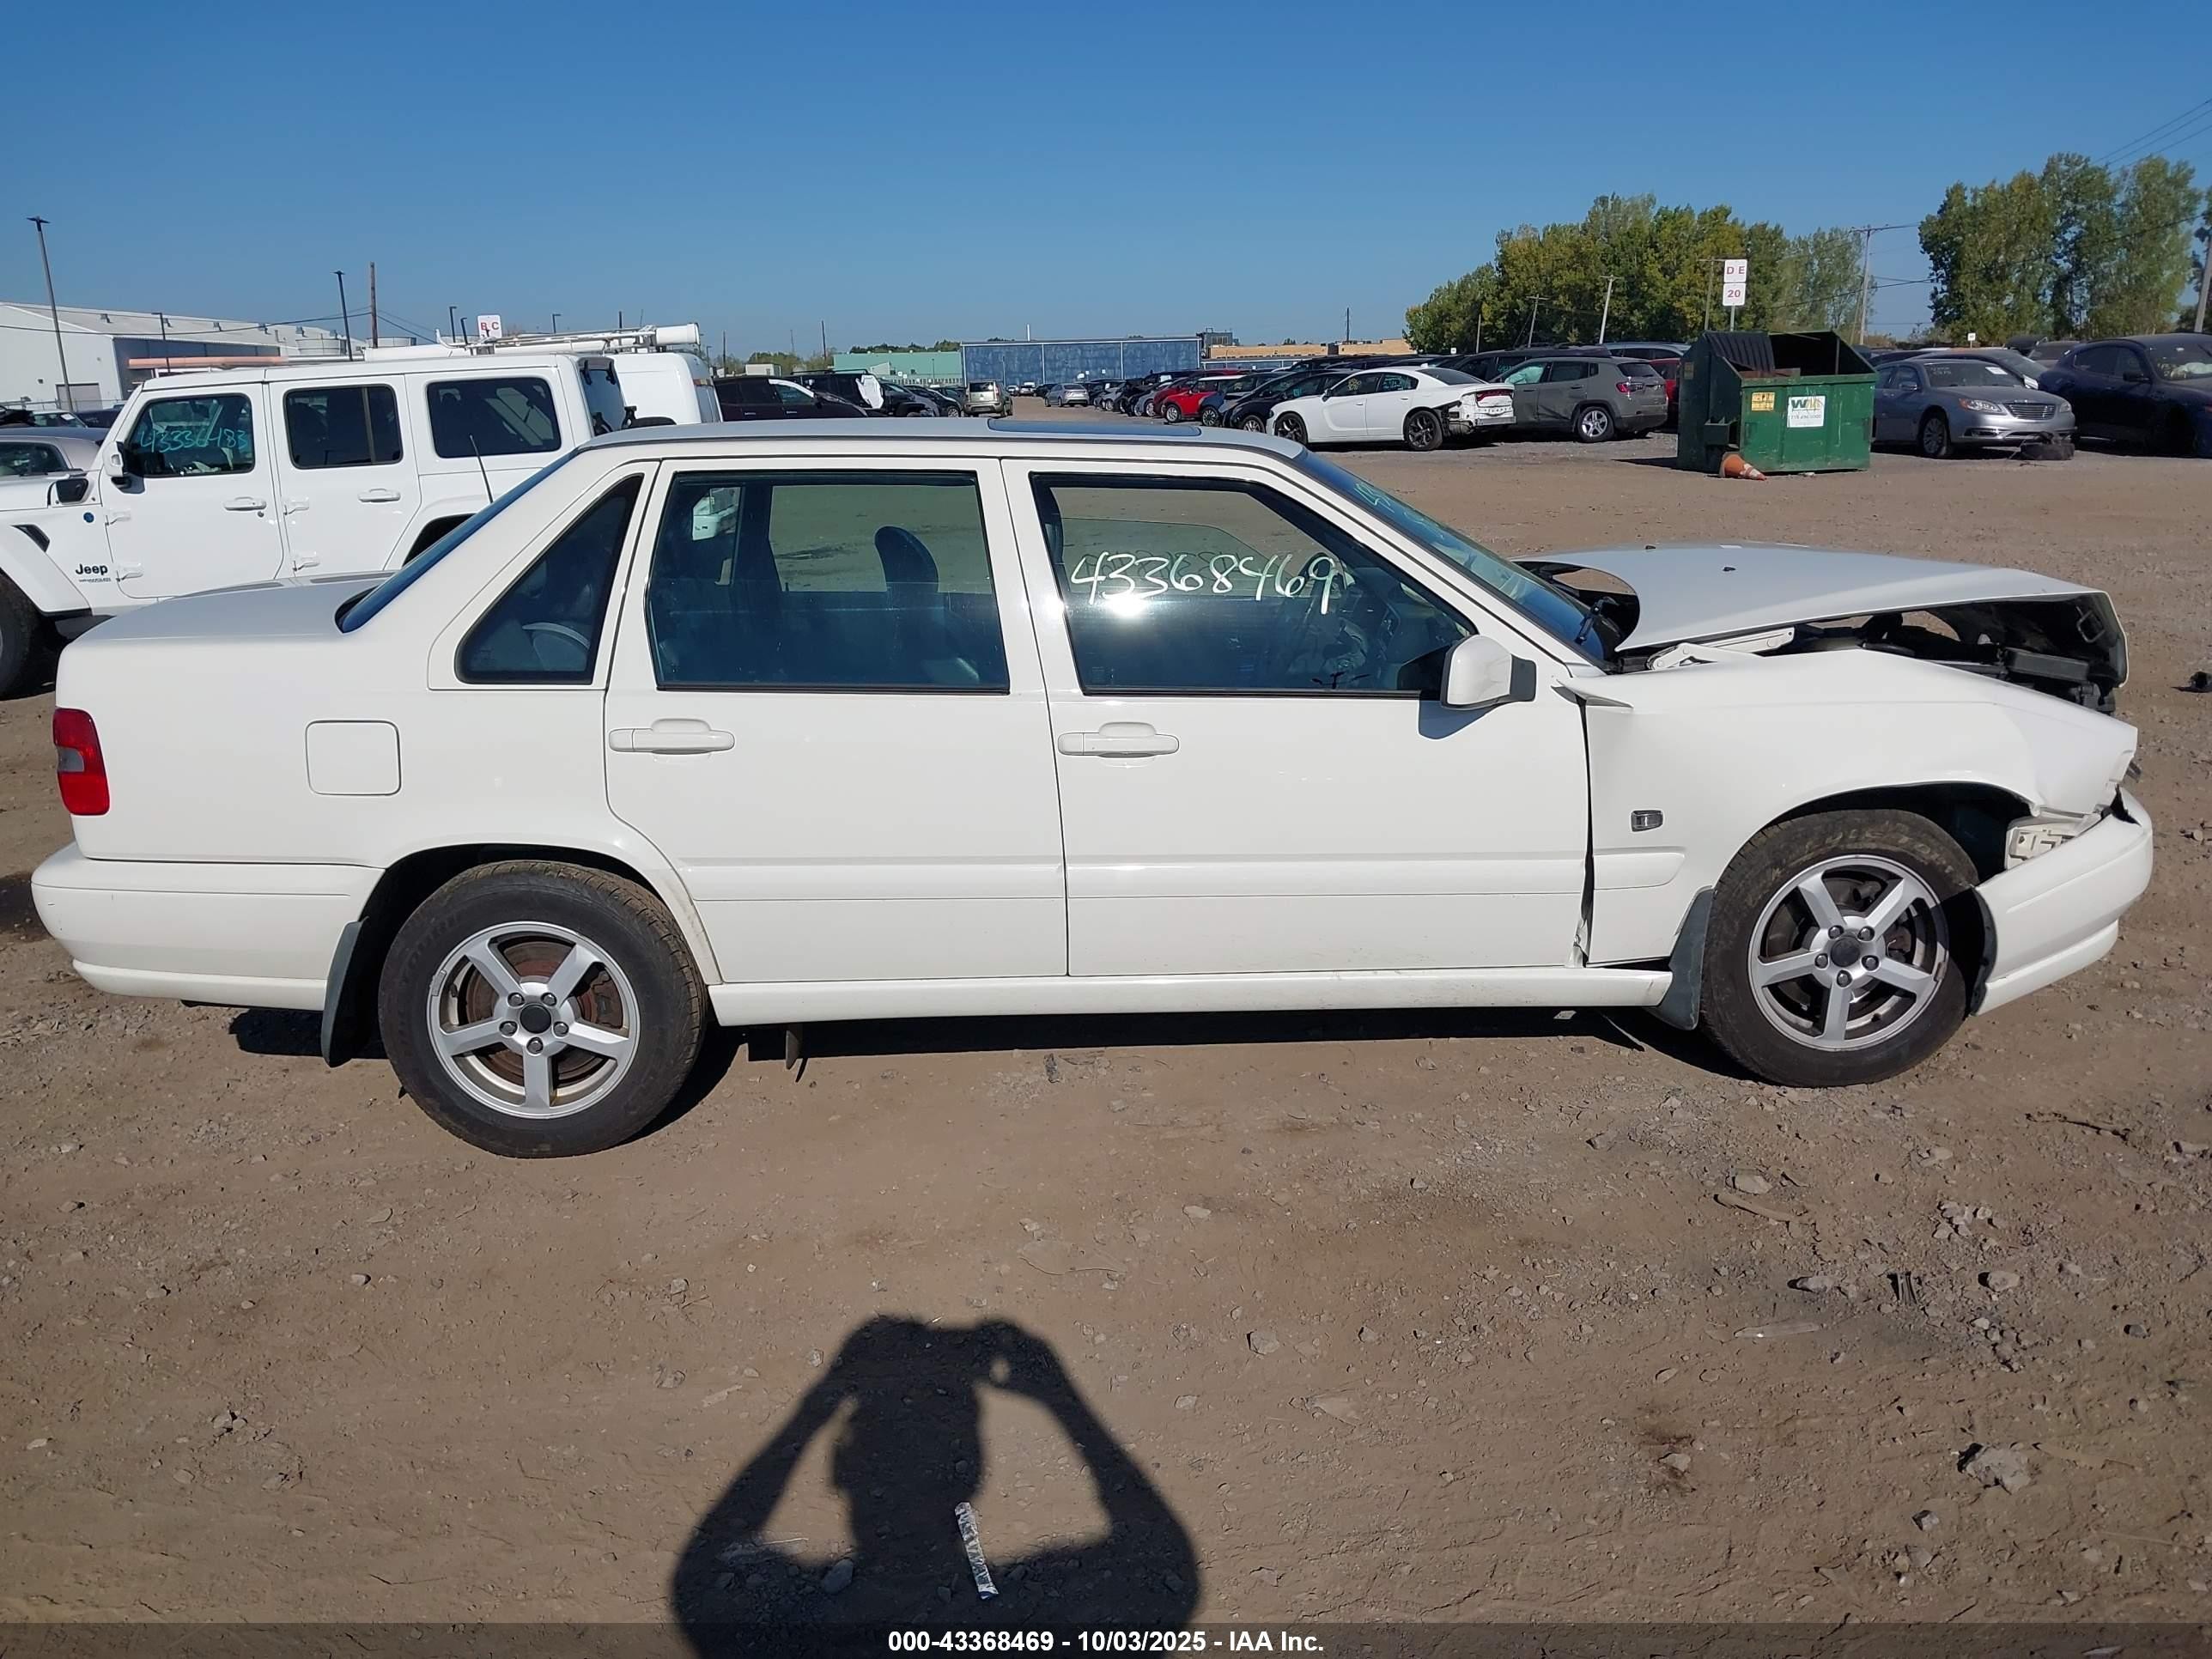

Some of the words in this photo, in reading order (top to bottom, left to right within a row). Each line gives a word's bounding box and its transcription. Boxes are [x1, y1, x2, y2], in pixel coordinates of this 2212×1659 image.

[1727, 266, 1735, 275] D
[1738, 266, 1745, 275] E
[1728, 289, 1741, 298] 20
[75, 563, 108, 576] Jeep
[1070, 550, 1338, 616] 43368469
